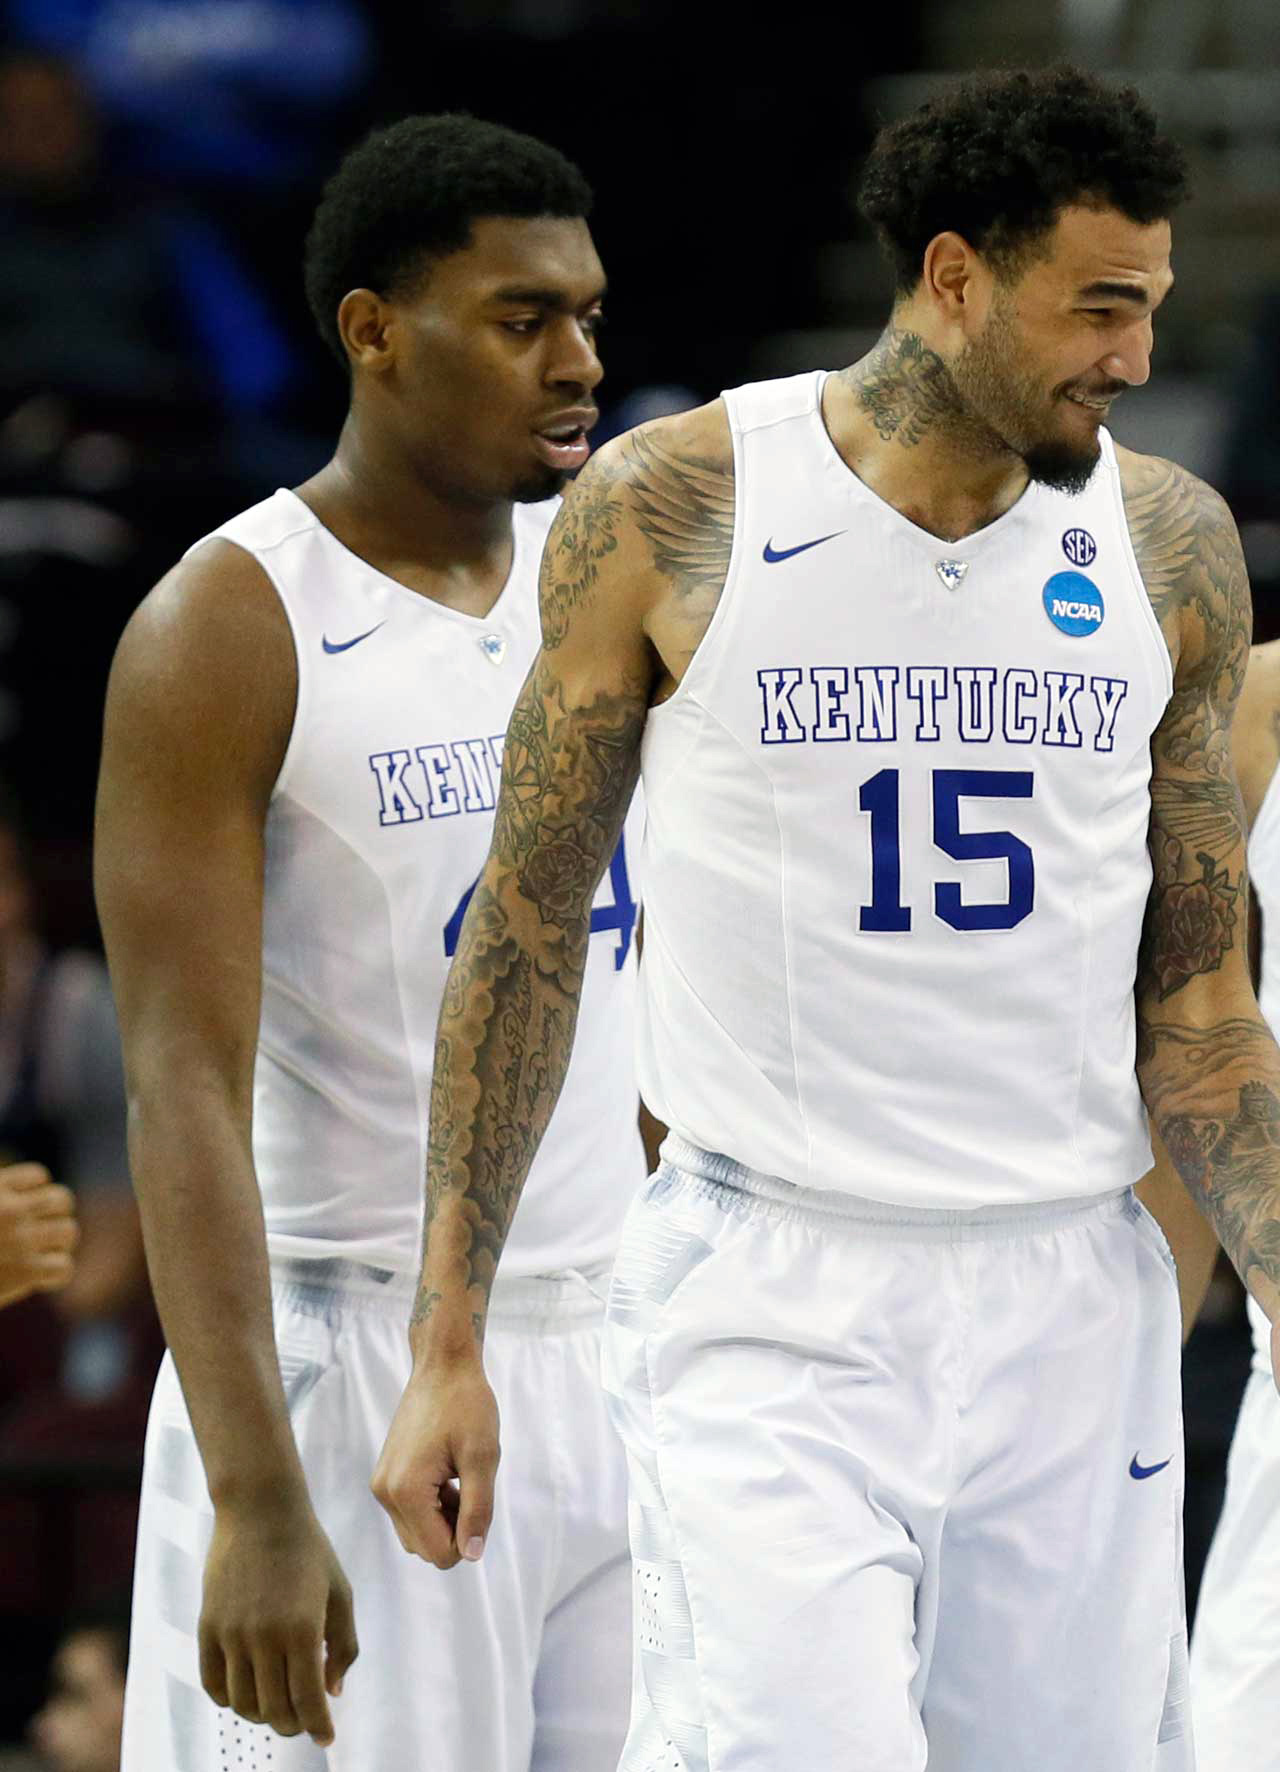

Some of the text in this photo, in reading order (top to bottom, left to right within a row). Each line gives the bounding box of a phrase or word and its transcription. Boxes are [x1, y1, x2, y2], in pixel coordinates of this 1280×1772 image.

[1063, 529, 1096, 566] SEC
[1052, 599, 1102, 623] NCAA
[757, 666, 1128, 752] KENTUCKY
[858, 768, 1035, 932] 15
